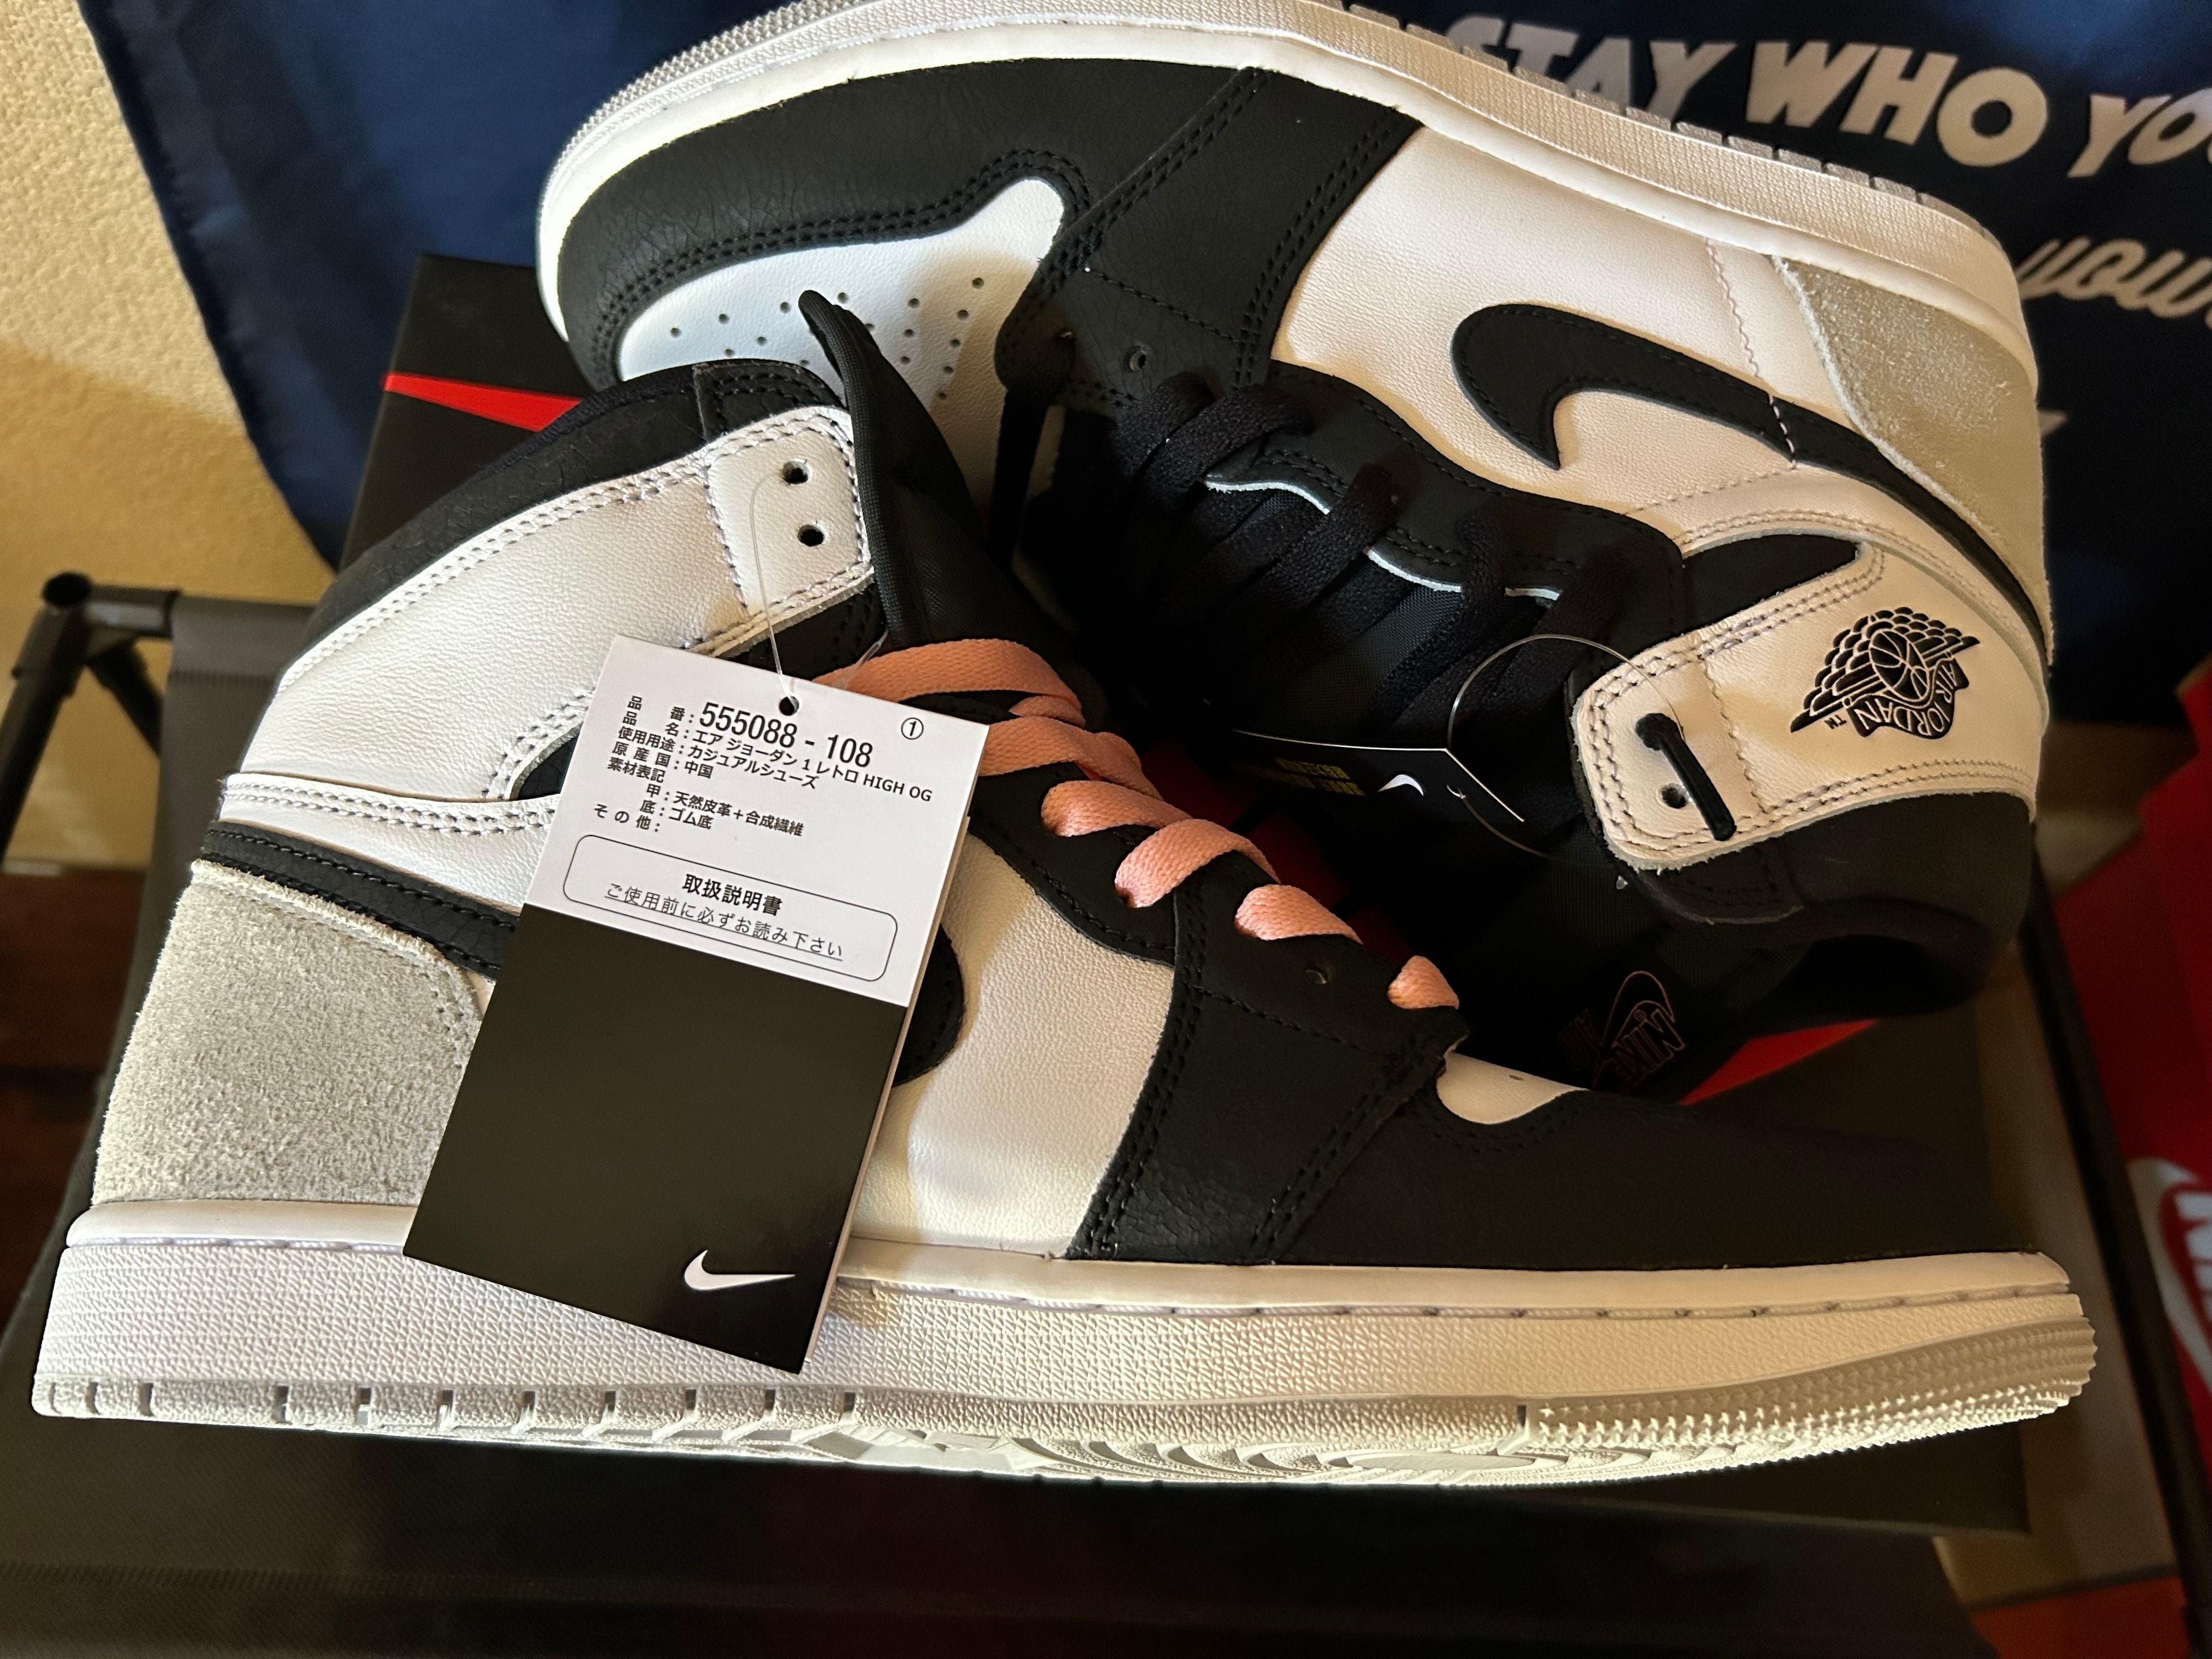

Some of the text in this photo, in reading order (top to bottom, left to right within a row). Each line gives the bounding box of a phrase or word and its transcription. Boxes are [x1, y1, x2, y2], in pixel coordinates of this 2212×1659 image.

[1746, 40, 2049, 167] WHO
[2066, 87, 2212, 178] YO
[607, 757, 666, 783] 素材表記
[863, 774, 905, 794] HIGH
[909, 786, 932, 802] OG
[682, 873, 783, 916] 取扱説明書
[606, 883, 843, 957] ご使用前に必ずお読み下さい
